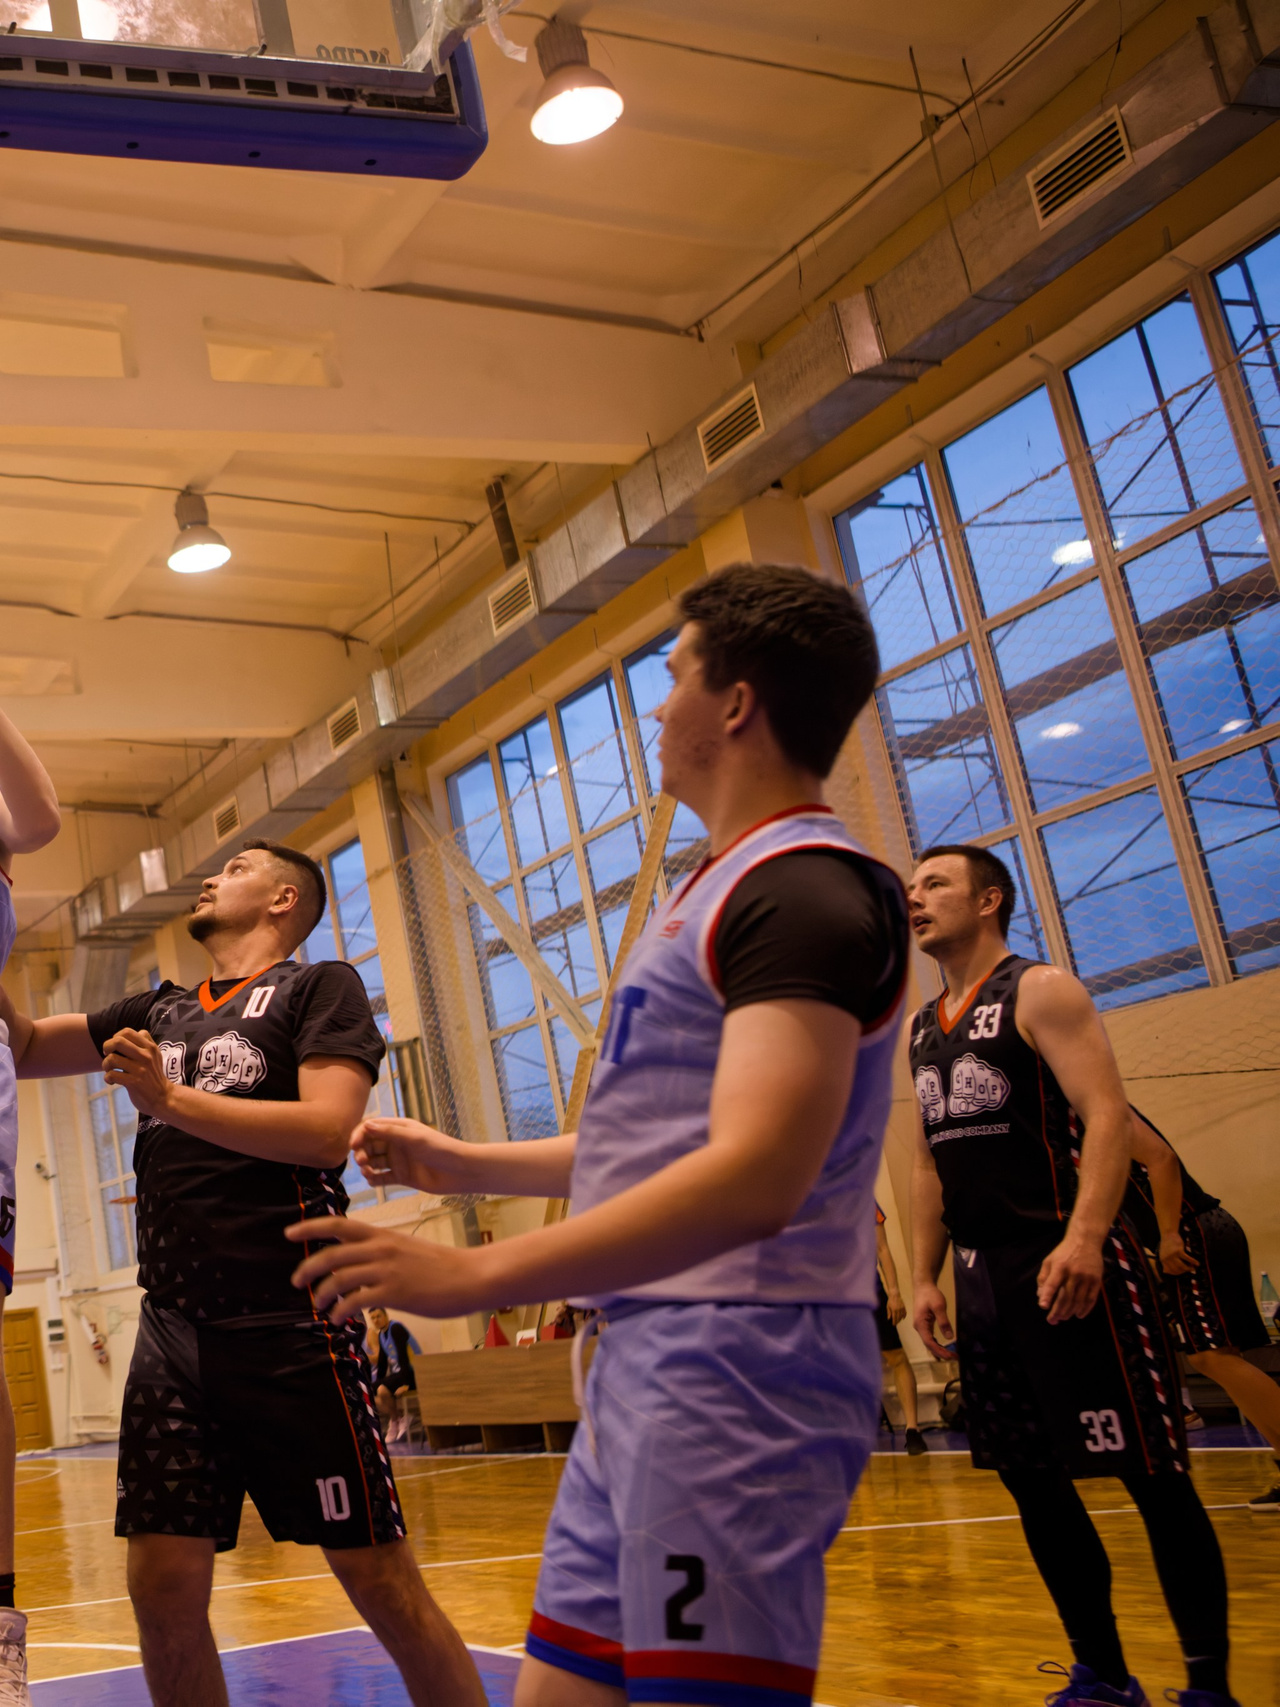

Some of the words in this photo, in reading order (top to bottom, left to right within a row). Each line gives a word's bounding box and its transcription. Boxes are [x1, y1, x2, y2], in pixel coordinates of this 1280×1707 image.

[241, 985, 276, 1019] 10
[968, 1003, 1003, 1040] 33
[965, 1123, 1010, 1136] COMPANY
[1079, 1409, 1125, 1452] 33
[315, 1475, 351, 1521] 10
[664, 1555, 705, 1642] 2
